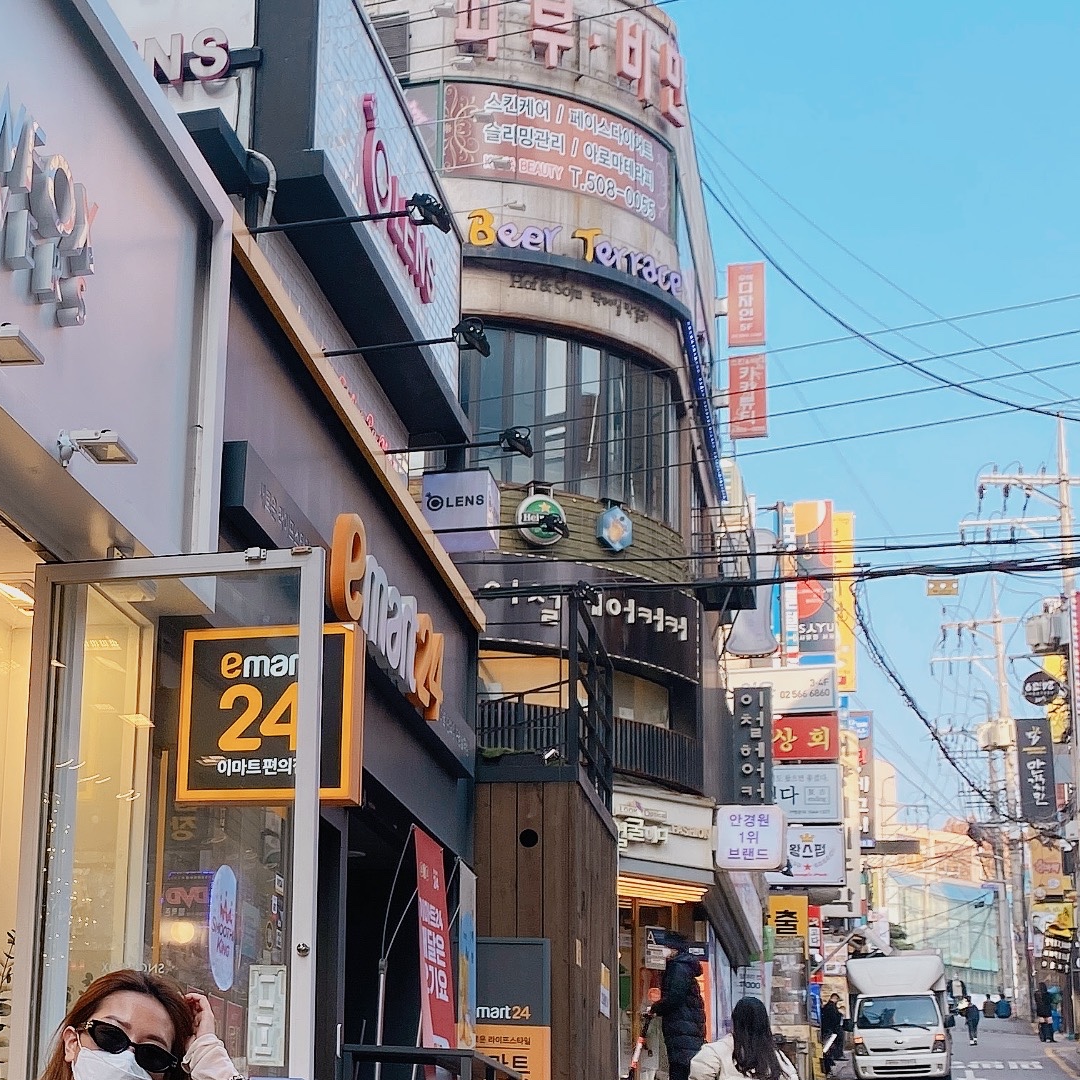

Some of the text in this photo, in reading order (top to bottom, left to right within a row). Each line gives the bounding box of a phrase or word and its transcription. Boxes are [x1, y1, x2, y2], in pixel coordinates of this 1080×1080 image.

[133, 27, 231, 82] NS
[484, 92, 550, 121] 스킨케어
[483, 122, 566, 155] 슬리밍관리
[583, 142, 655, 193] 아로마테라피
[467, 208, 683, 296] Beer Terrace
[221, 652, 299, 679] emar
[217, 683, 299, 752] 24
[217, 757, 299, 776] 이마트 편의
[729, 814, 770, 828] 안경원
[728, 848, 769, 861] 브랜드
[476, 1005, 531, 1020] mart24
[488, 1036, 531, 1046] 라이프스타일
